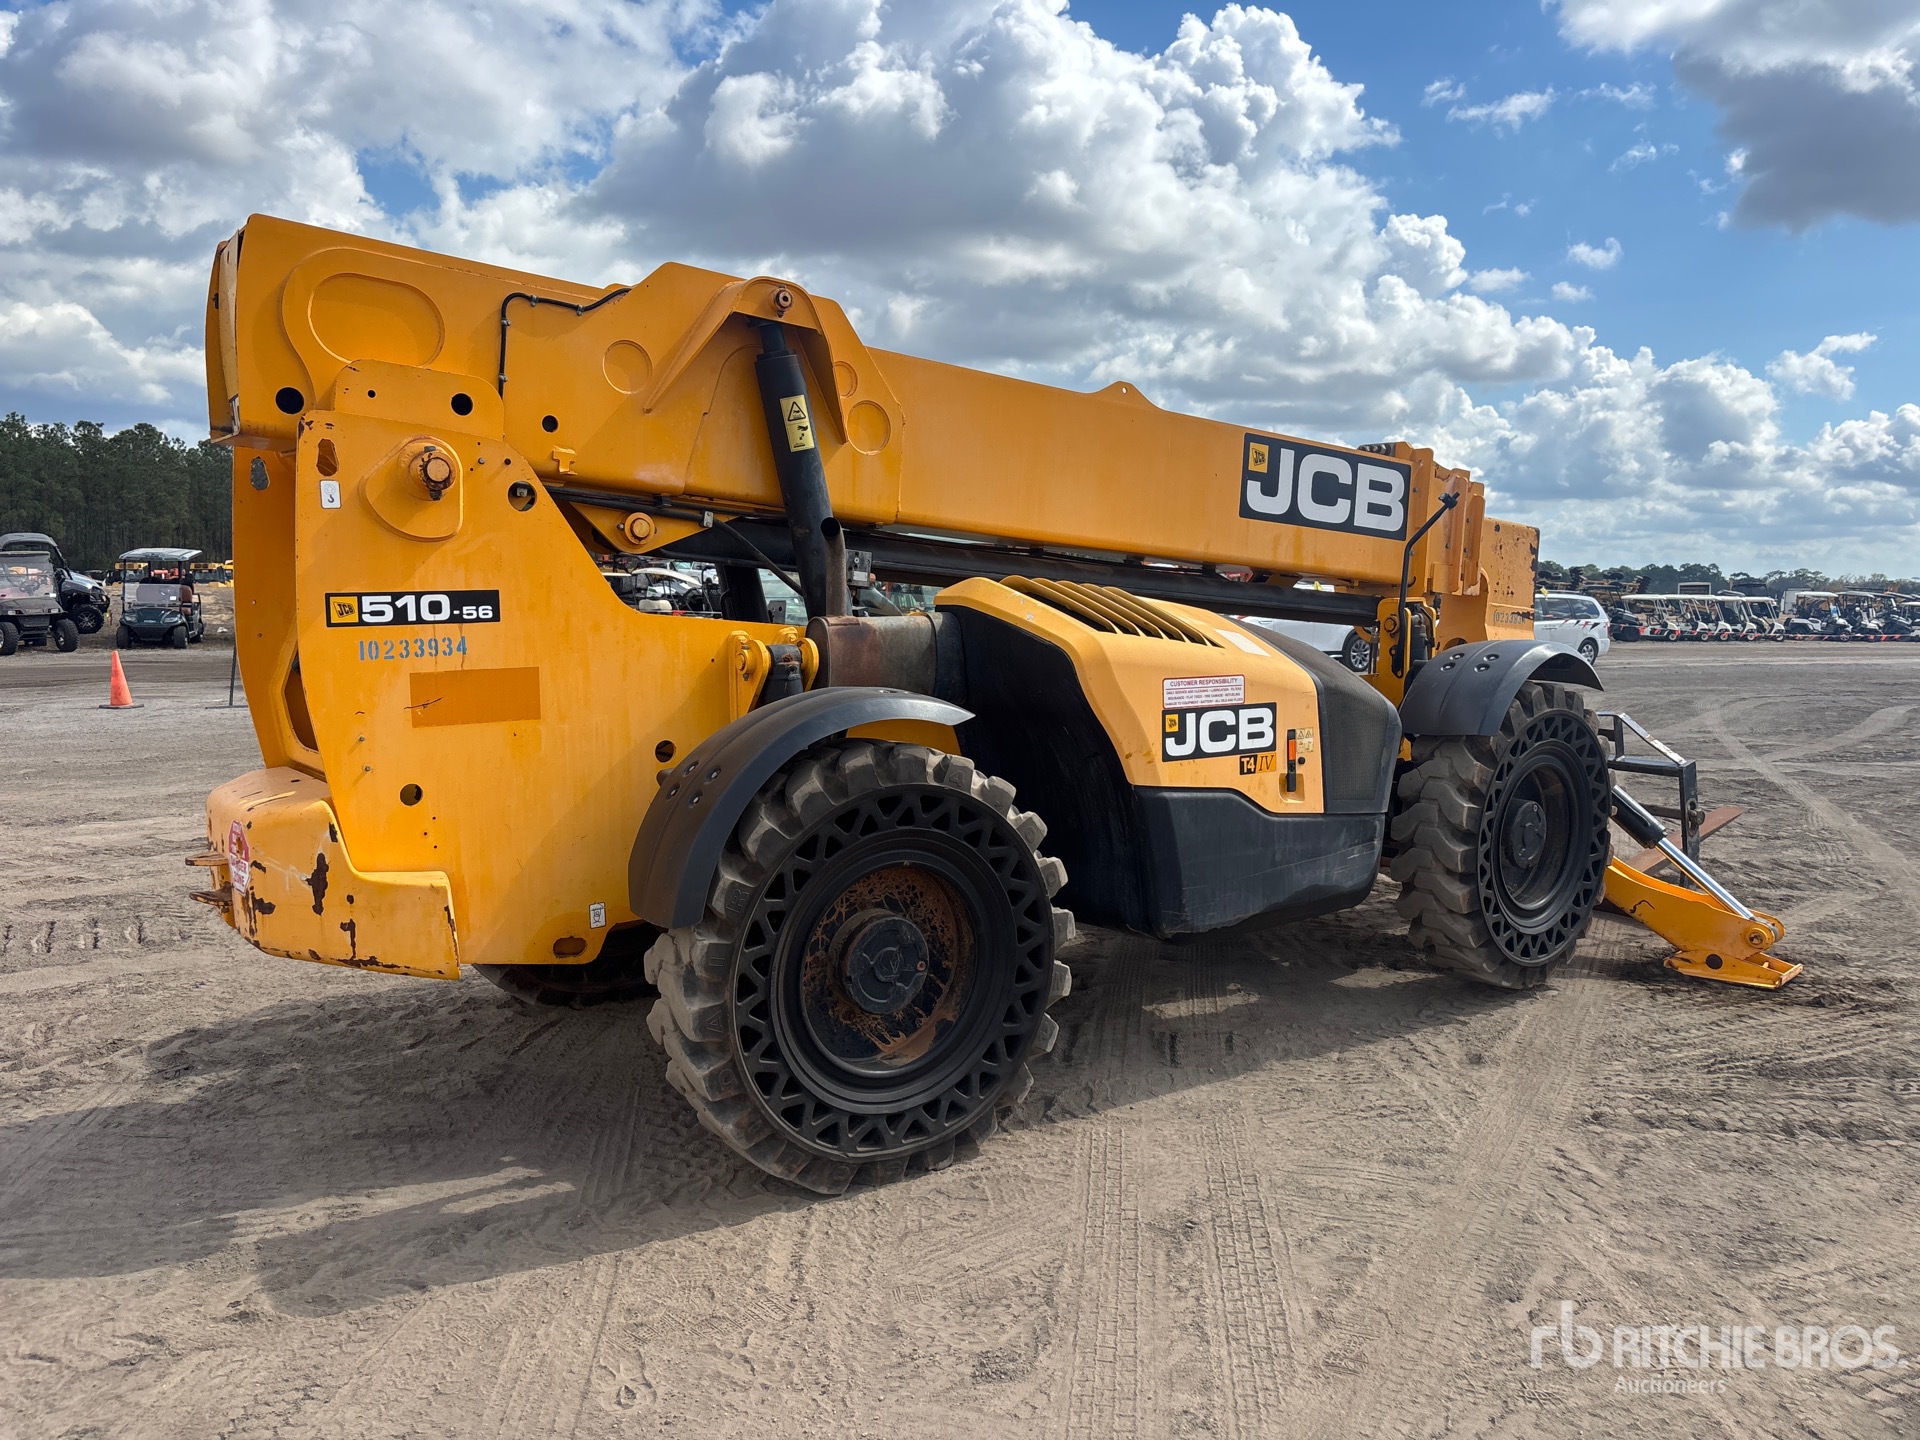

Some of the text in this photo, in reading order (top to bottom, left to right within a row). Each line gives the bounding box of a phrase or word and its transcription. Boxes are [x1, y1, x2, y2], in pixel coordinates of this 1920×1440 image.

[1247, 448, 1405, 532] JCB
[336, 602, 355, 618] JCB
[361, 594, 493, 623] 510-56
[359, 636, 468, 661] 10233934
[1169, 678, 1238, 687] CUSTOMER RESPONSIBILITY
[1165, 707, 1274, 757] JCB
[1241, 755, 1275, 773] T4 IV
